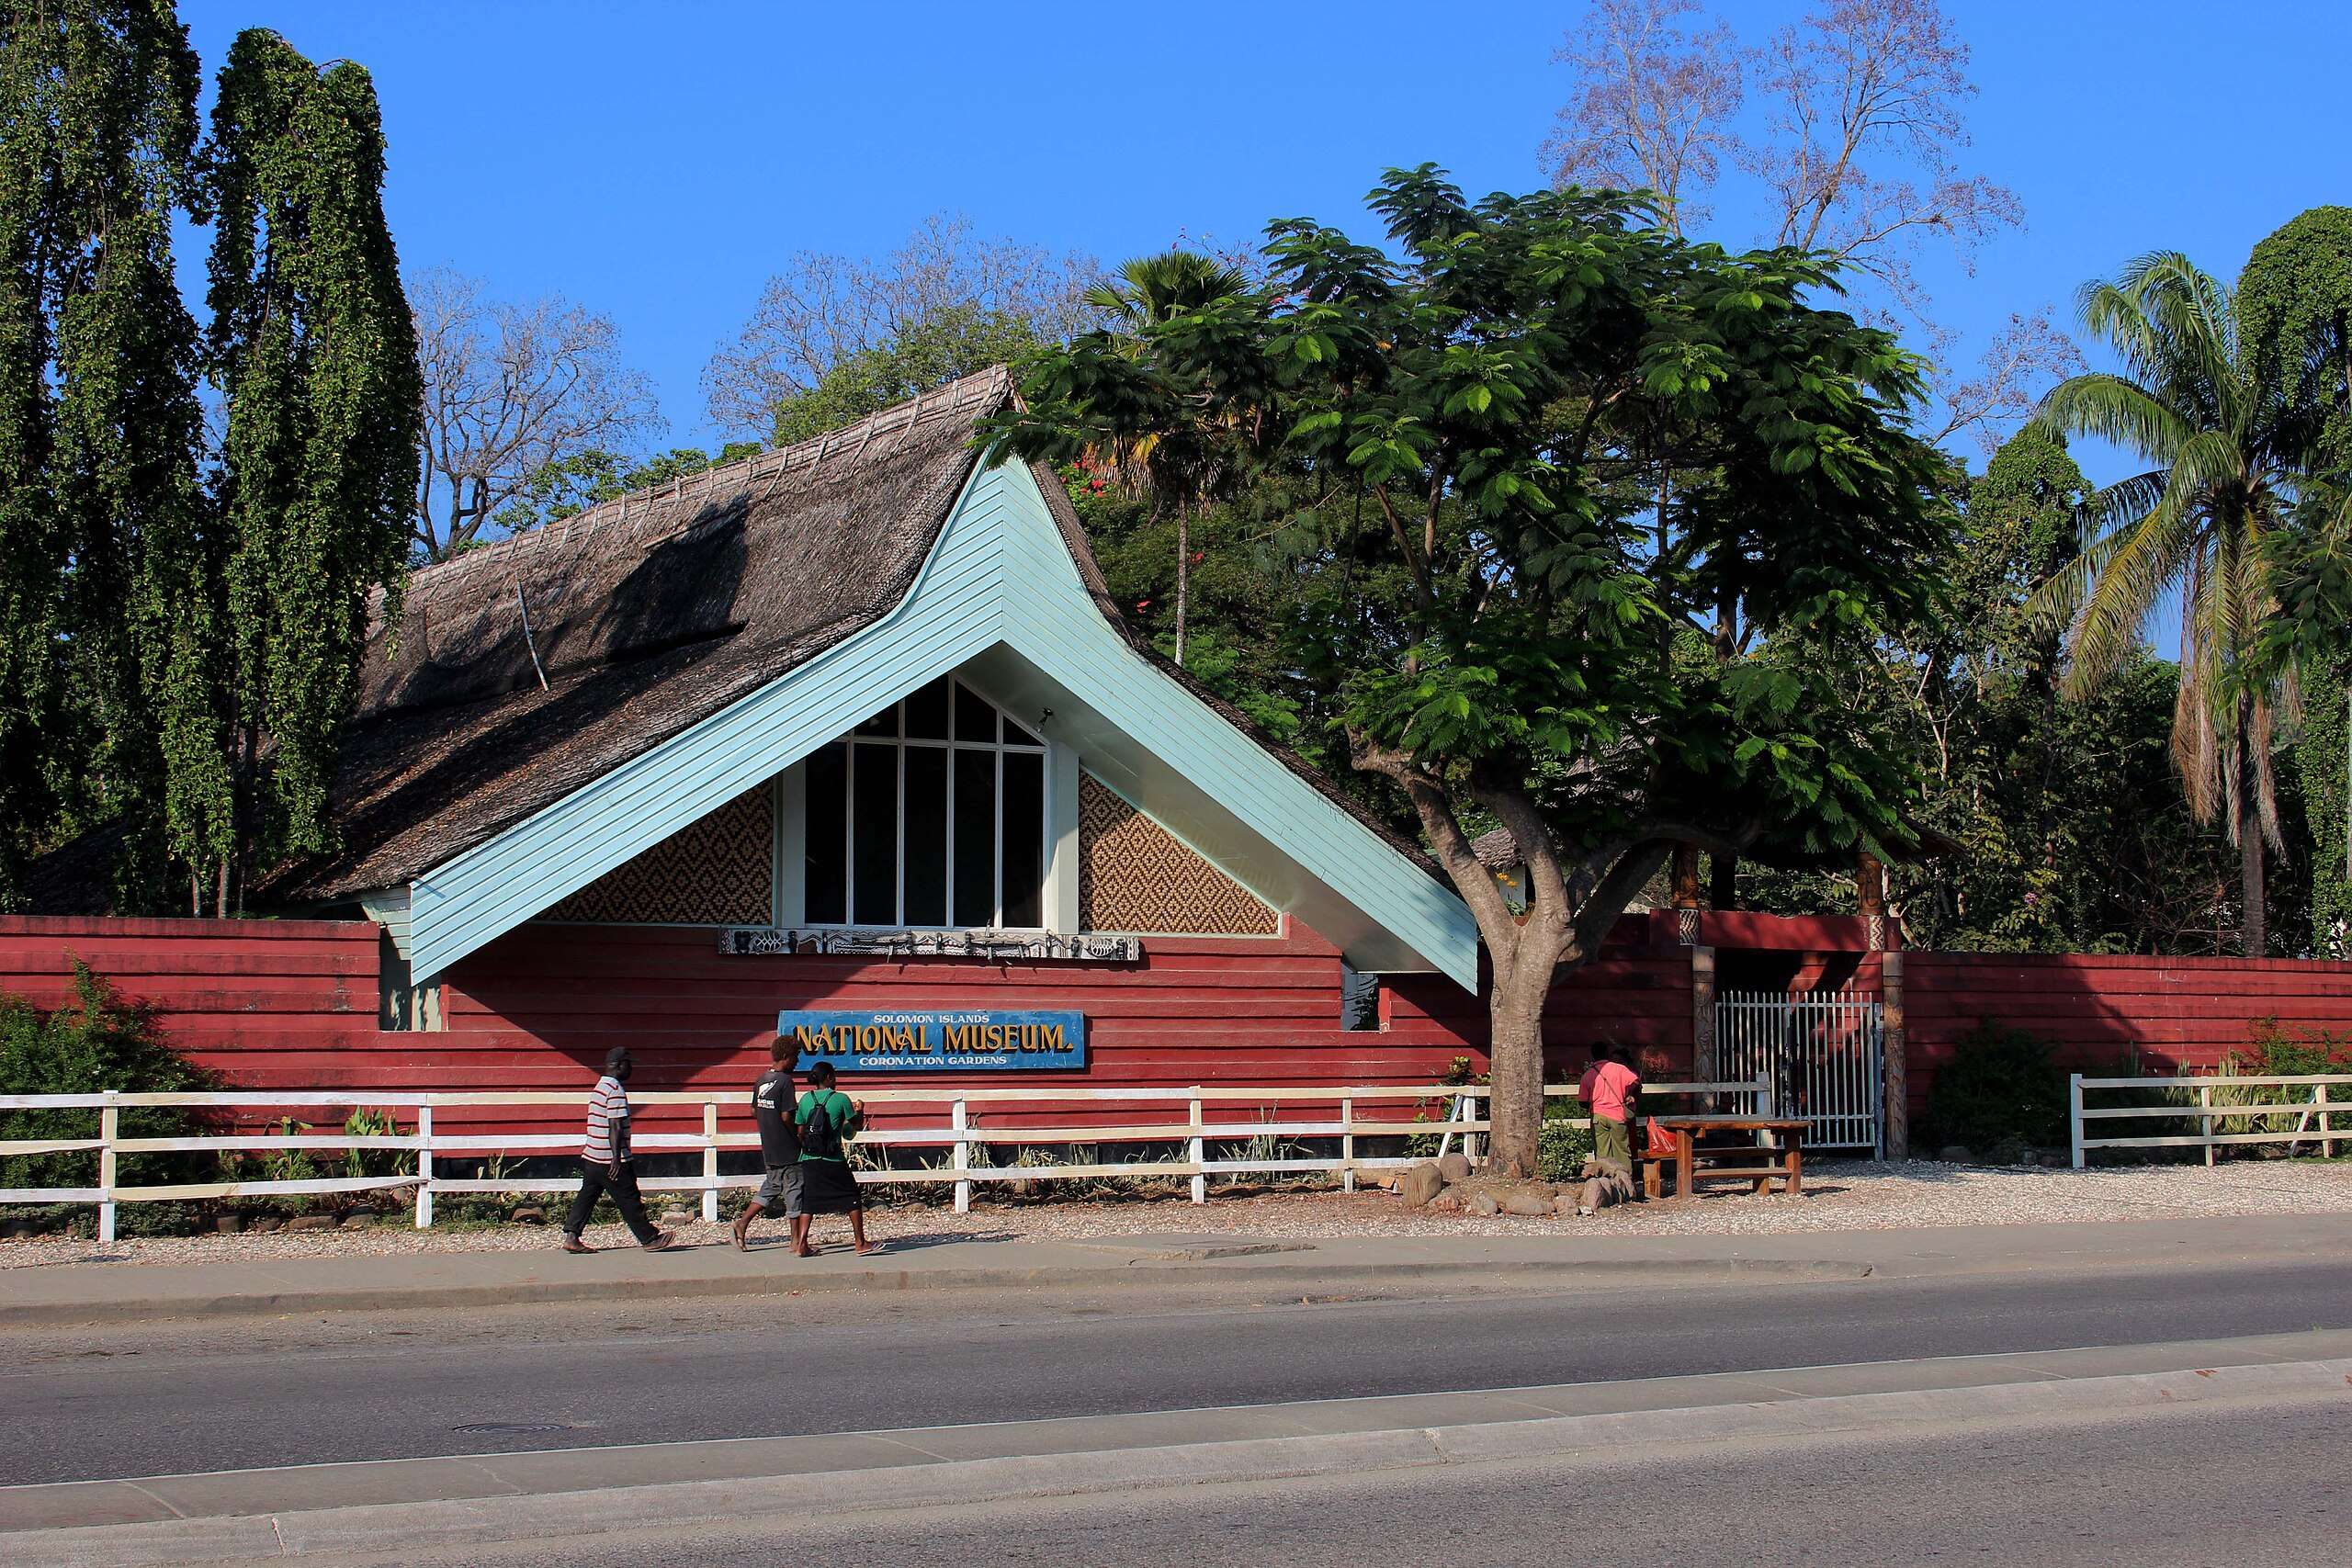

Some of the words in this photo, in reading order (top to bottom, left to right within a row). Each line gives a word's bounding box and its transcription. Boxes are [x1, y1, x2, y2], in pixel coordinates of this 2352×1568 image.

[874, 1014, 933, 1023] SOLOMON
[939, 1014, 989, 1023] ISLANDS
[795, 1024, 934, 1053] NATIONAL
[859, 1056, 944, 1066] CORONATION
[948, 1055, 1007, 1066] GARDENS
